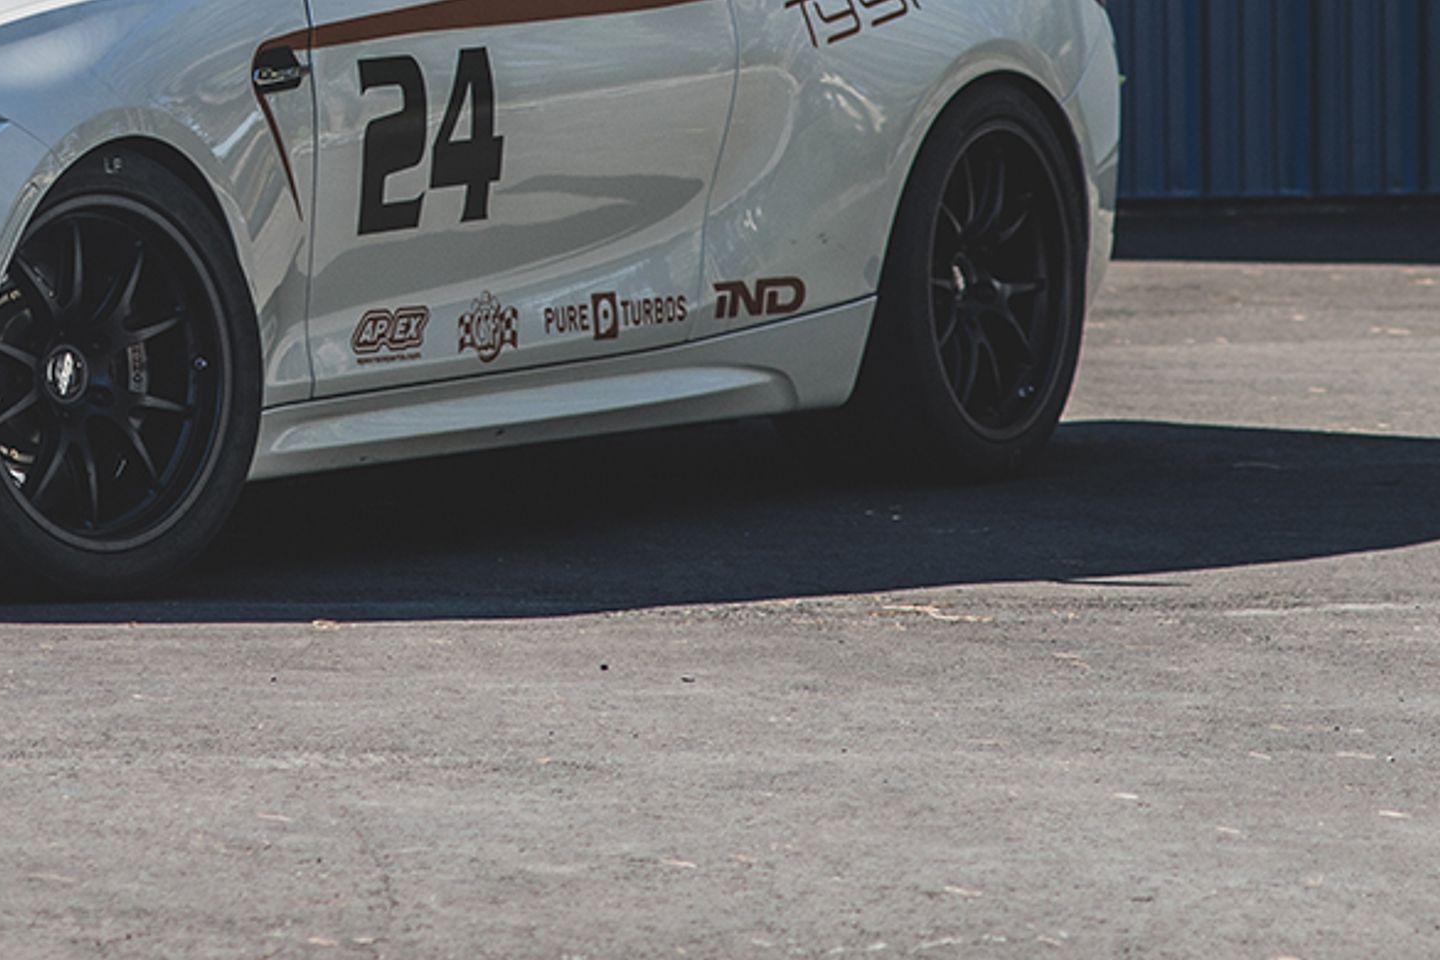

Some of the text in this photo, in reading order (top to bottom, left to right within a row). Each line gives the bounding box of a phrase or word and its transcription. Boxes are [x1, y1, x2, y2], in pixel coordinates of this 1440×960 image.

[357, 46, 503, 236] 24
[356, 311, 426, 349] APEX
[543, 304, 590, 334] PURE
[620, 295, 687, 327] TURBOS
